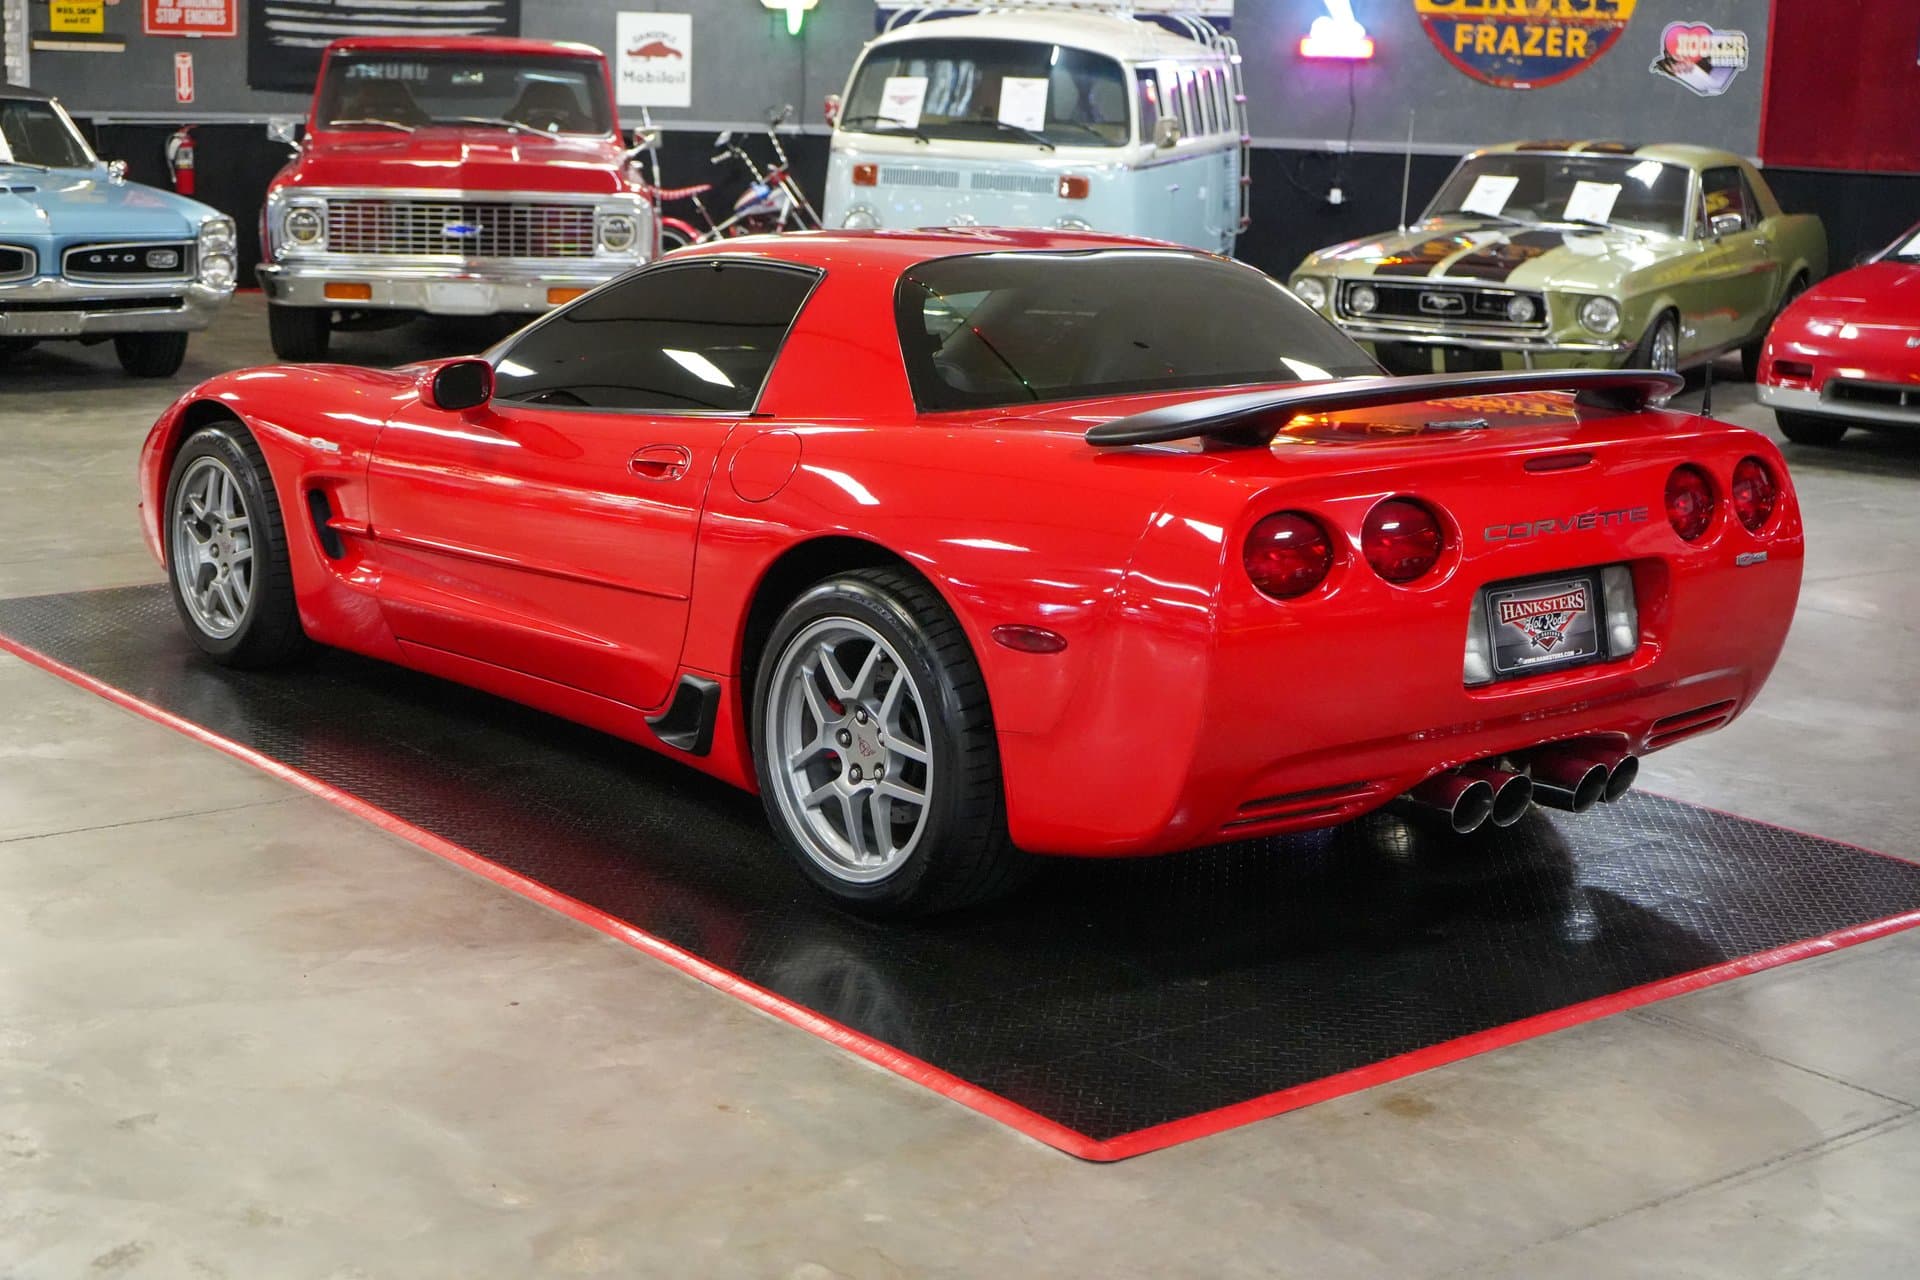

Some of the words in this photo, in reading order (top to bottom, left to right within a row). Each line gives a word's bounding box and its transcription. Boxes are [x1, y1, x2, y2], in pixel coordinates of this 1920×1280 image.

[155, 8, 182, 24] STOP
[184, 9, 226, 25] ENGINES
[1454, 24, 1588, 58] FRAZER
[1676, 33, 1746, 57] HOOKER
[623, 70, 686, 84] Mobiloil
[89, 254, 136, 263] GTO
[1484, 506, 1649, 542] CORVETTE
[1502, 592, 1584, 620] HANKSTERS
[1524, 615, 1544, 632] Hot
